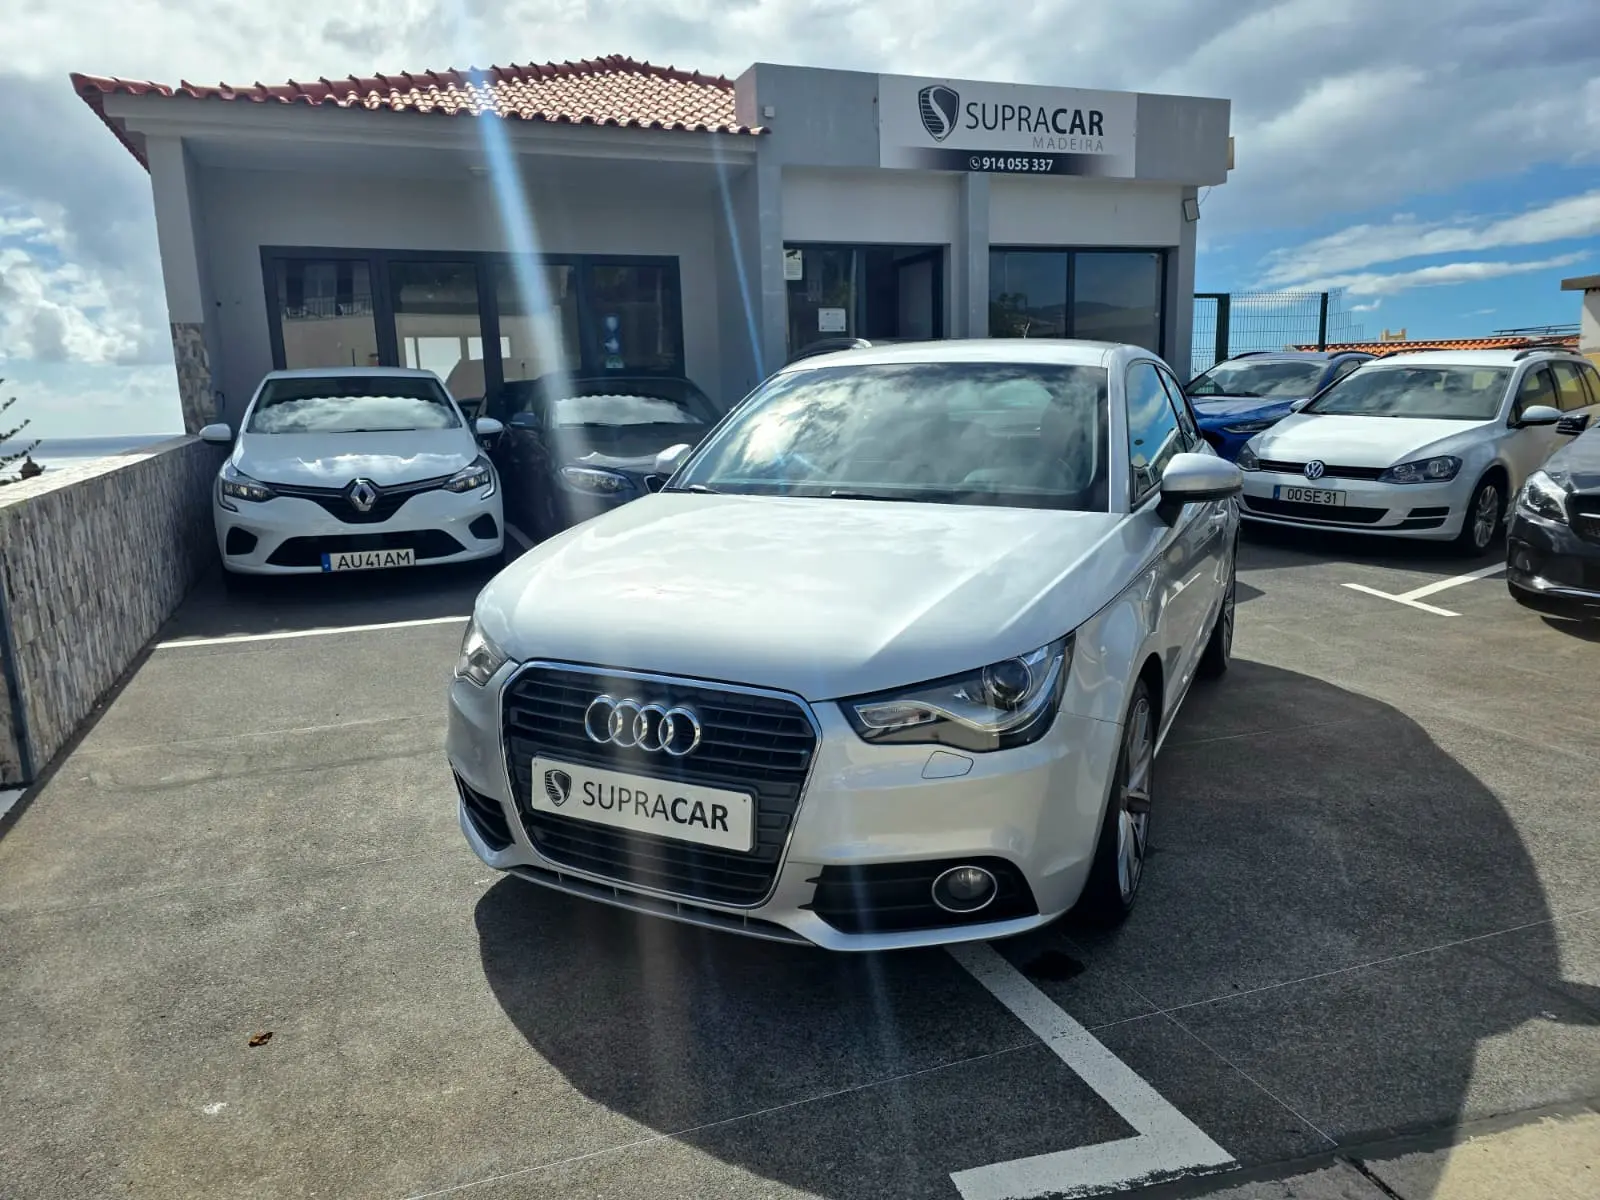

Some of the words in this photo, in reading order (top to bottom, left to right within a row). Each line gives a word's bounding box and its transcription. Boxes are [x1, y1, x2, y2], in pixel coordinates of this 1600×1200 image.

[966, 102, 1104, 136] SUPRACAR
[1031, 136, 1104, 152] MADEIRA
[982, 157, 1006, 170] 914
[1007, 158, 1030, 171] 055
[1031, 160, 1053, 173] 337
[582, 781, 729, 832] SUPRACAR
